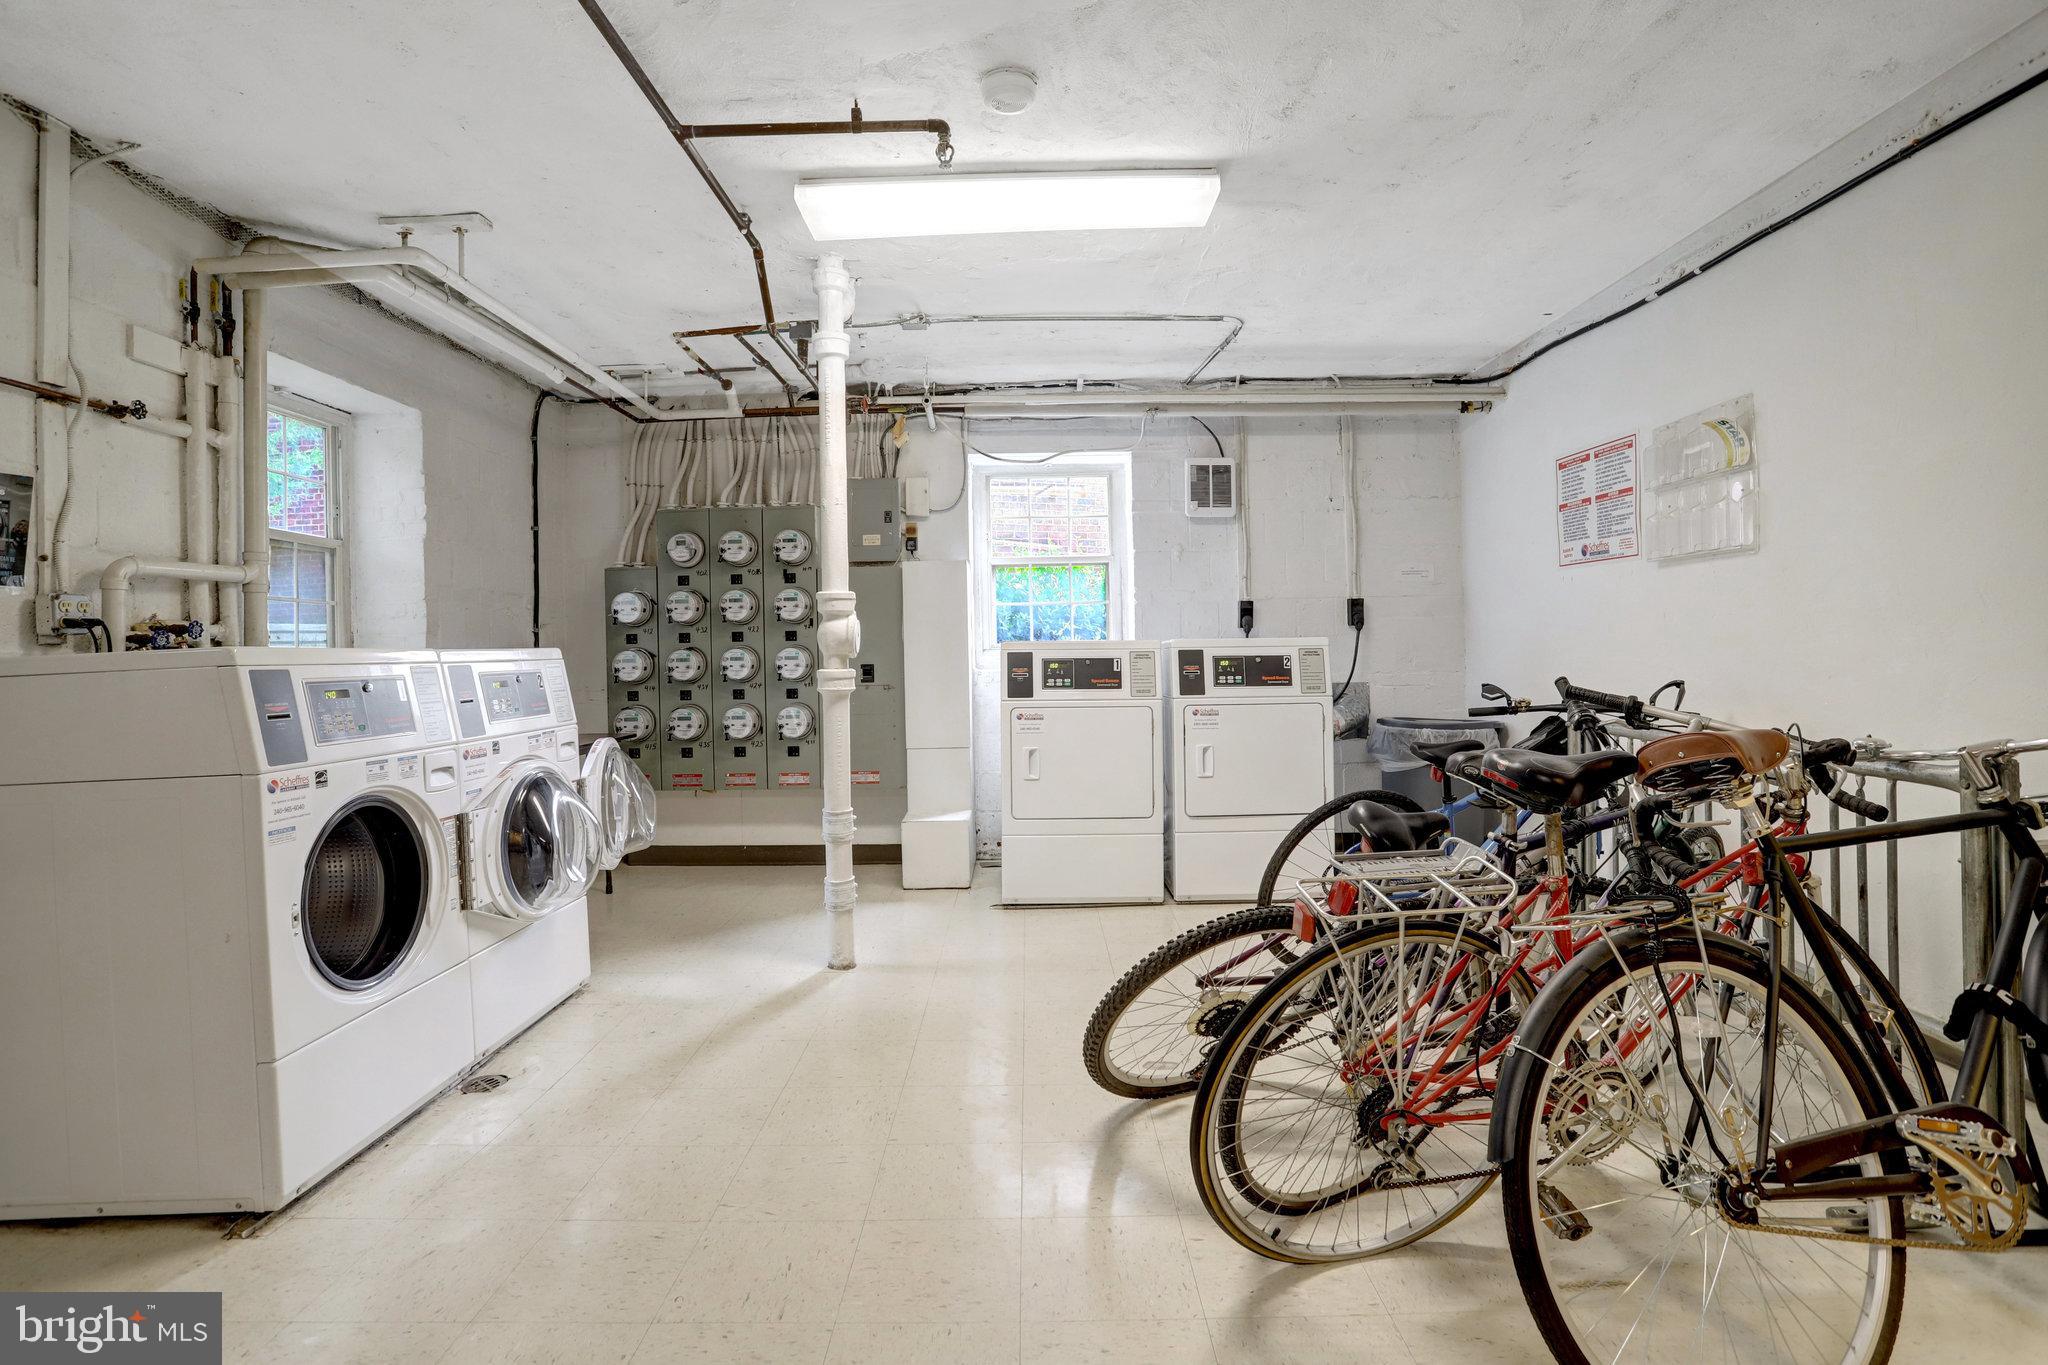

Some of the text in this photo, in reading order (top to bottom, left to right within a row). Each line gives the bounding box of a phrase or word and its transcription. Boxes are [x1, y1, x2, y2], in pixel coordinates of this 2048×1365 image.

[1115, 659, 1120, 671] 1
[1284, 657, 1290, 668] 2
[537, 674, 544, 688] 2
[280, 775, 310, 787] Scheffres
